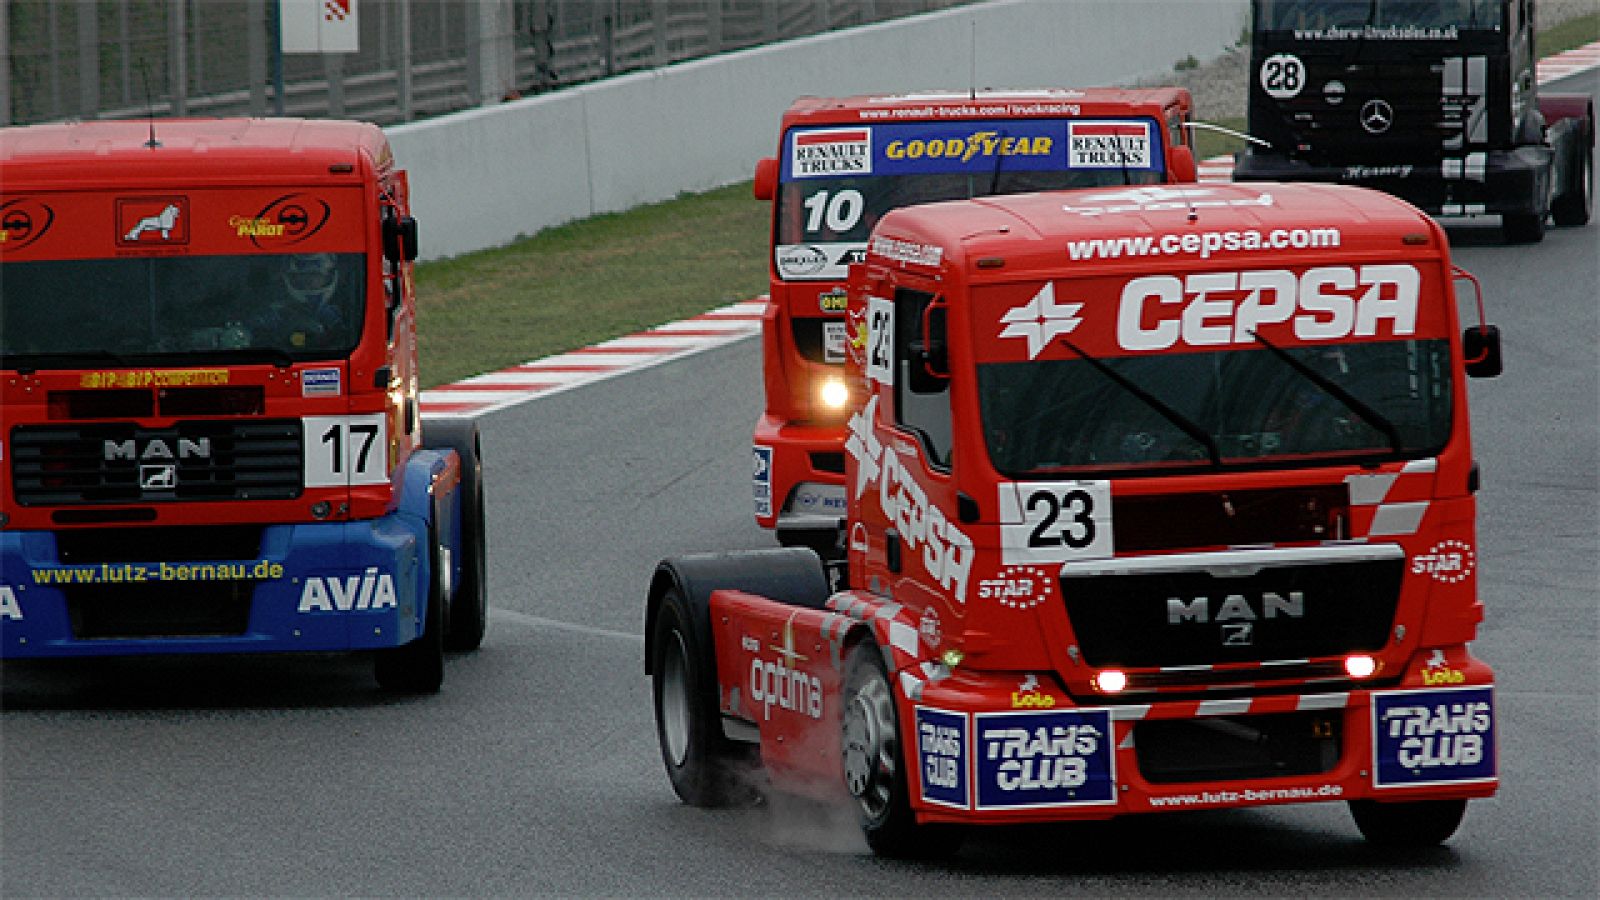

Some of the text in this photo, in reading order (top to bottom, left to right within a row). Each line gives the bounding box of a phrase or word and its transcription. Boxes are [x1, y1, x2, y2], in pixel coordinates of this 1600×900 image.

[1267, 61, 1300, 91] 28
[797, 143, 868, 161] RENAULT
[885, 131, 1053, 163] GOODYEAR
[1071, 135, 1146, 153] RENAULT
[1076, 150, 1144, 165] TRUCKS
[801, 159, 864, 174] TRUCKS
[803, 189, 864, 232] 10
[1067, 227, 1341, 260] www.cepsa.com
[1117, 264, 1421, 351] CEPSA
[104, 437, 210, 461] MAN
[320, 423, 379, 474] 17
[880, 446, 975, 603] CEPSA
[1026, 489, 1096, 549] 23
[32, 560, 284, 585] www.lutz-bernau.de
[1412, 552, 1462, 574] STAR
[978, 578, 1034, 600] STAR
[1166, 591, 1304, 624] MAN
[751, 656, 823, 721] optima
[1381, 701, 1492, 738] TRANS
[919, 721, 961, 758] TRANS
[981, 725, 1103, 760] TRANS
[1398, 733, 1484, 769] CLUB
[924, 754, 960, 790] CLUB
[996, 756, 1088, 791] CLUB
[1148, 783, 1344, 807] www.lutz-bernau.de
